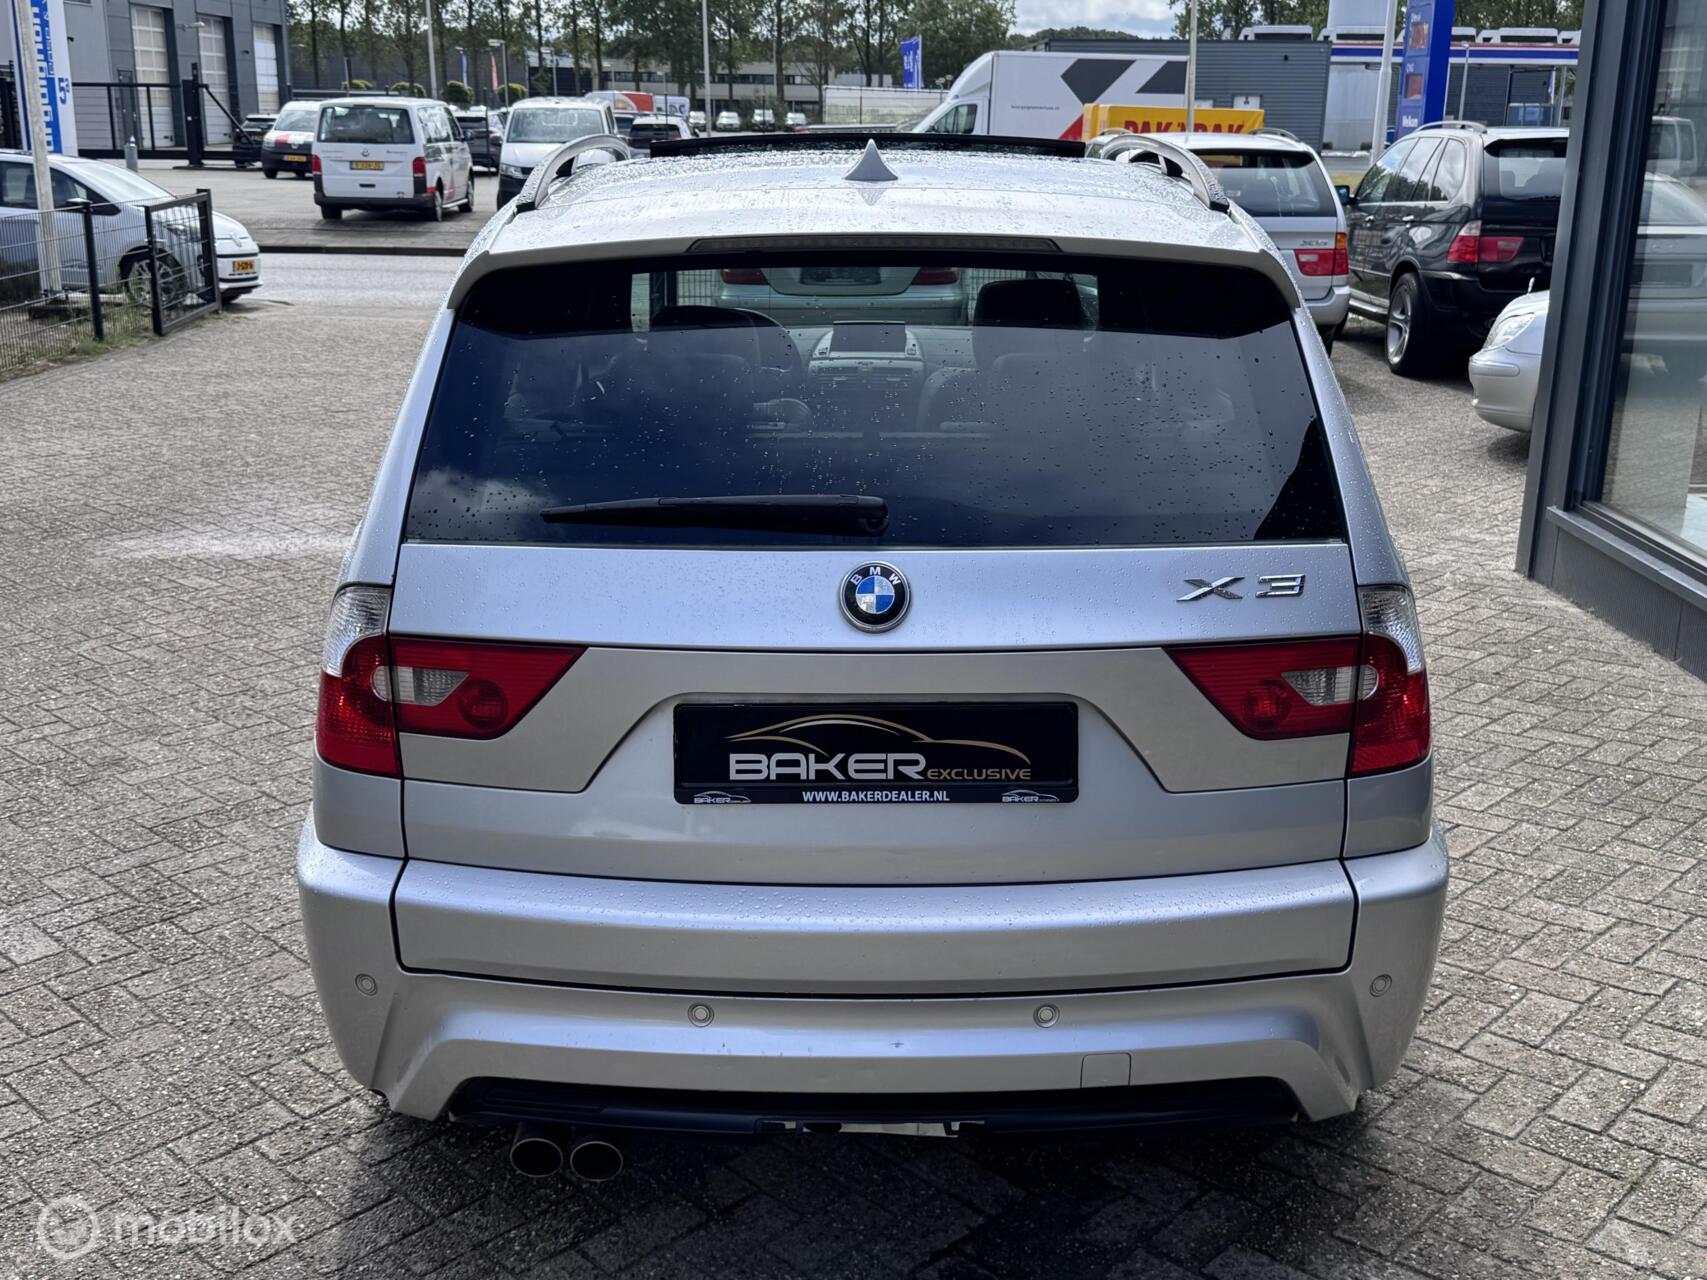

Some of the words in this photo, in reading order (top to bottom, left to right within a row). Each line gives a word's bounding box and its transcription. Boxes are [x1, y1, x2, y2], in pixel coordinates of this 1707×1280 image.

[850, 566, 901, 586] BMW
[729, 753, 926, 780] BAKER
[927, 768, 1031, 780] EXCLUSIVE
[802, 790, 950, 802] WWW.BAKERDEALER.NL
